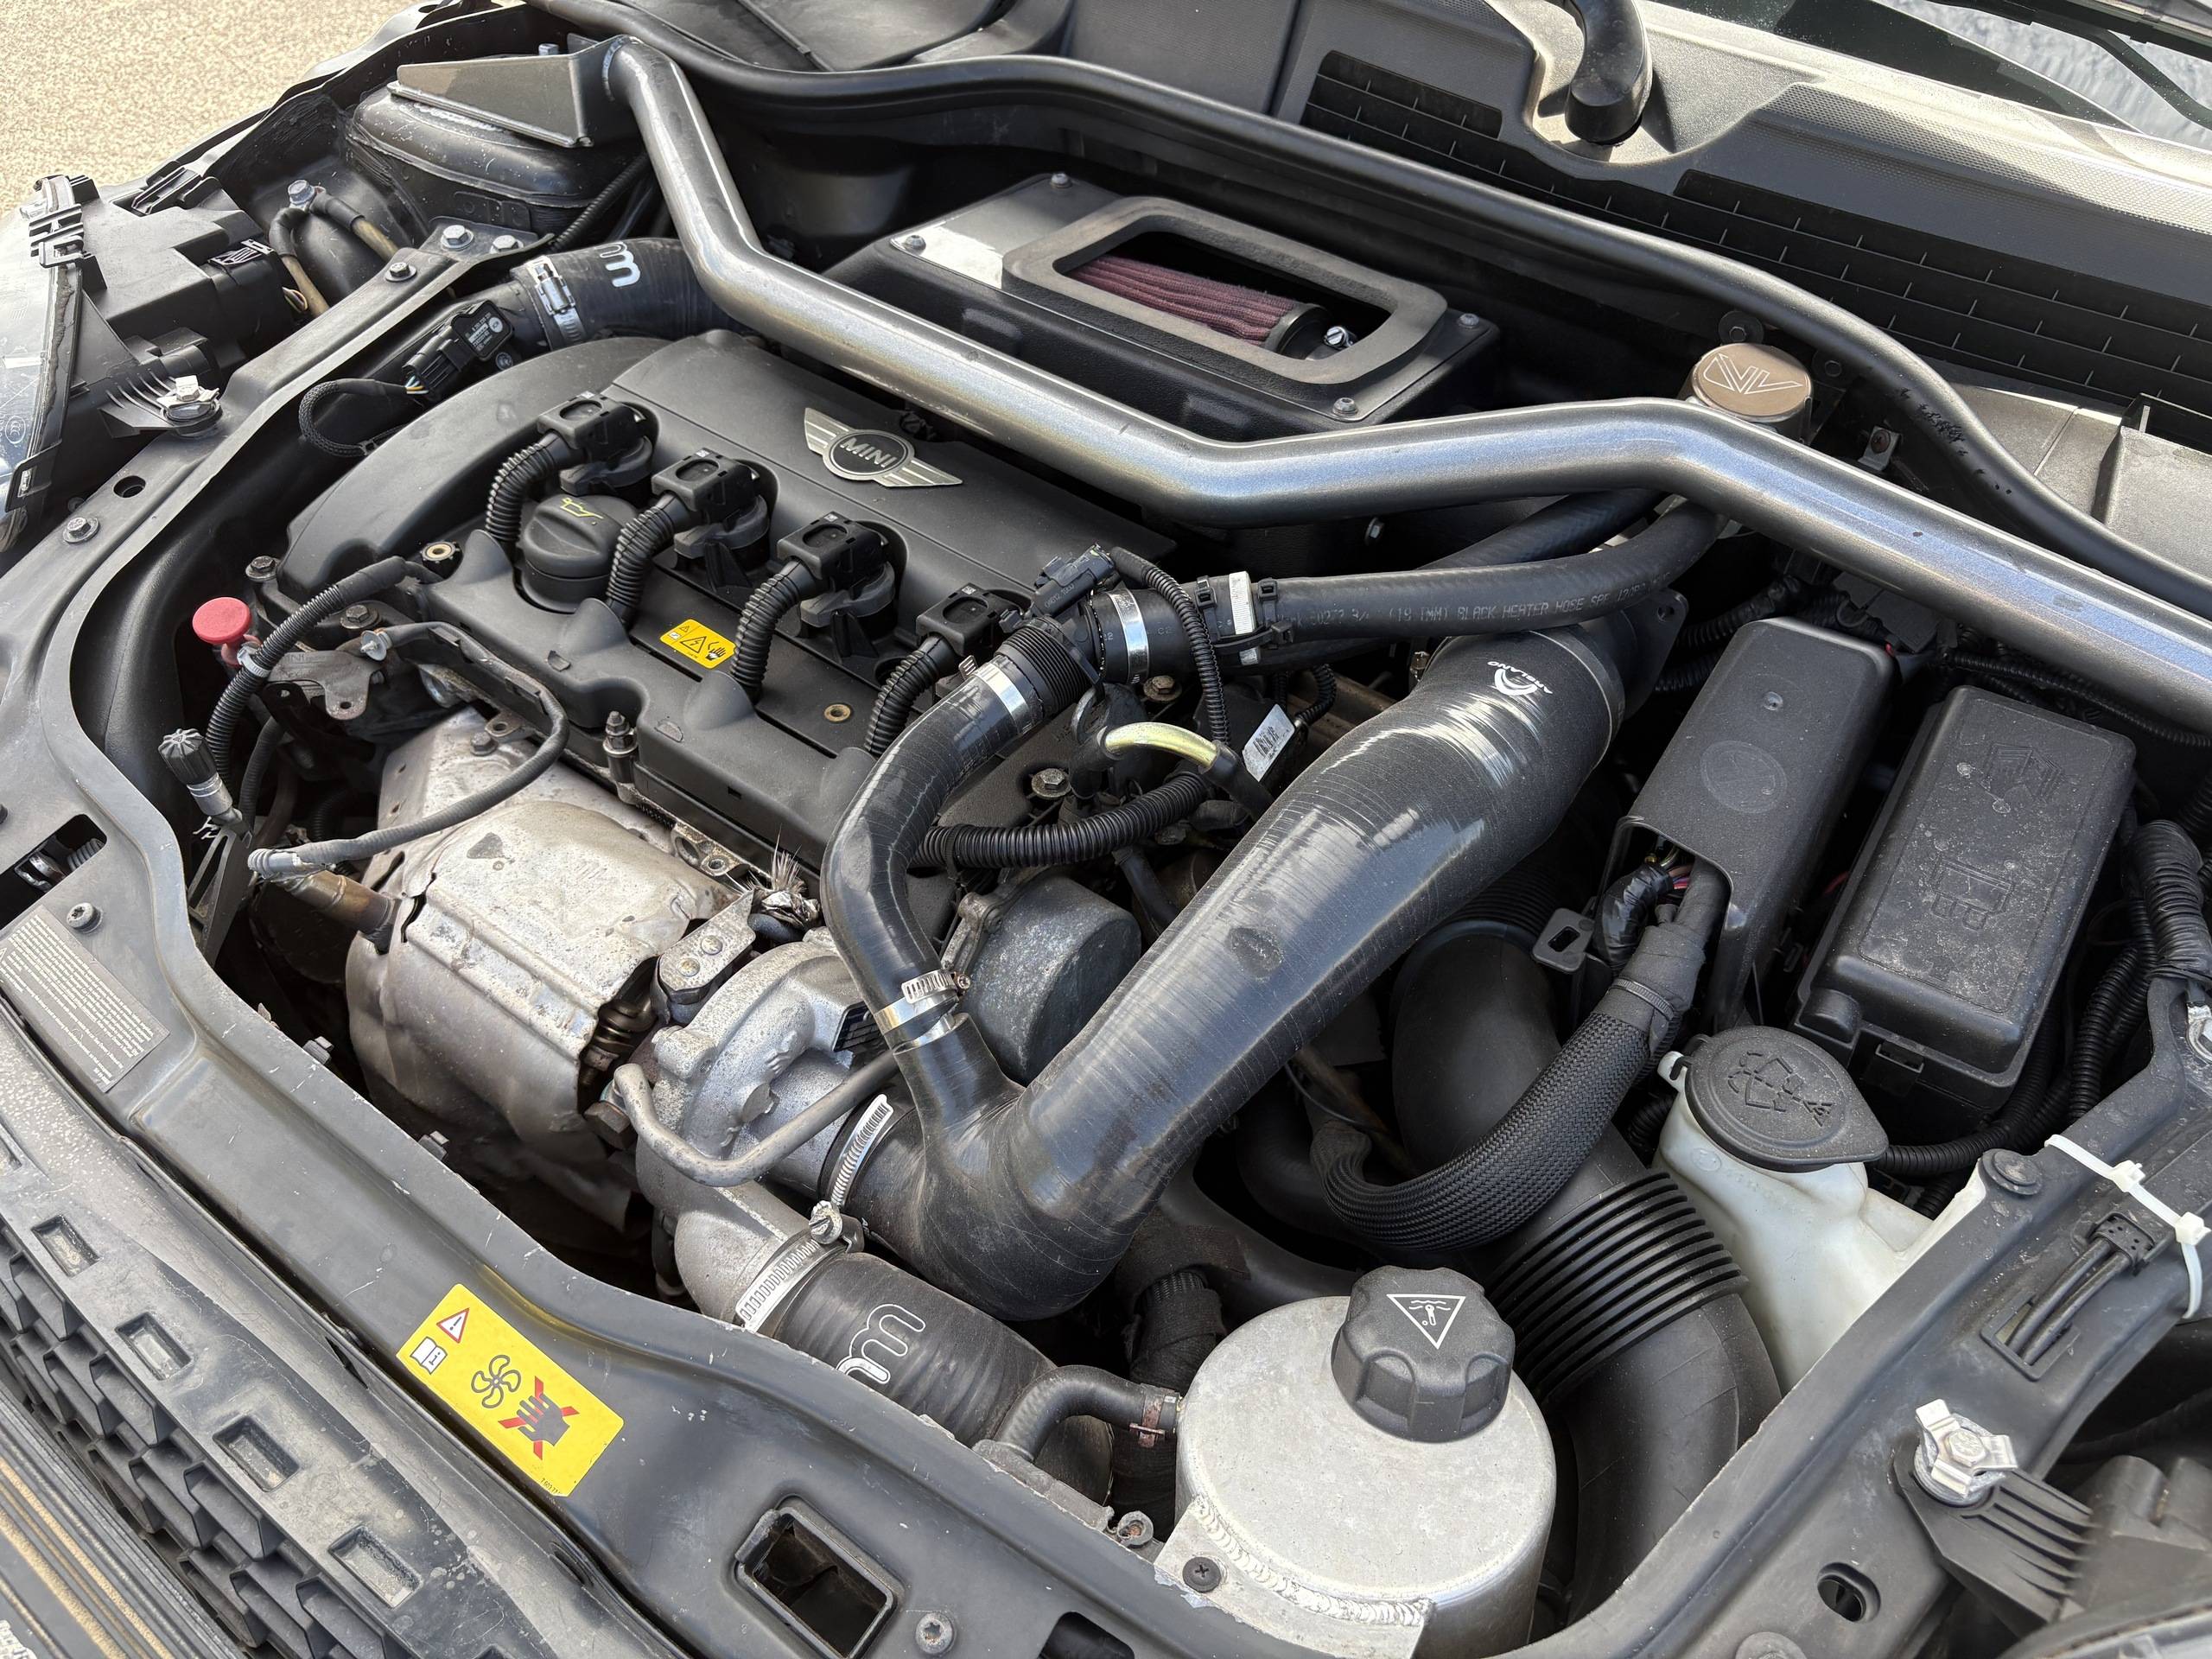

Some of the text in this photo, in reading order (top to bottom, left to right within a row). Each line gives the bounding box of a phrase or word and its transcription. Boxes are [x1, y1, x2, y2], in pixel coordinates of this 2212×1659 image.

[839, 436, 898, 468] MINI
[1457, 605, 1497, 621] BLACK
[1502, 601, 1549, 619] HEATER
[1554, 597, 1586, 613] HOSE
